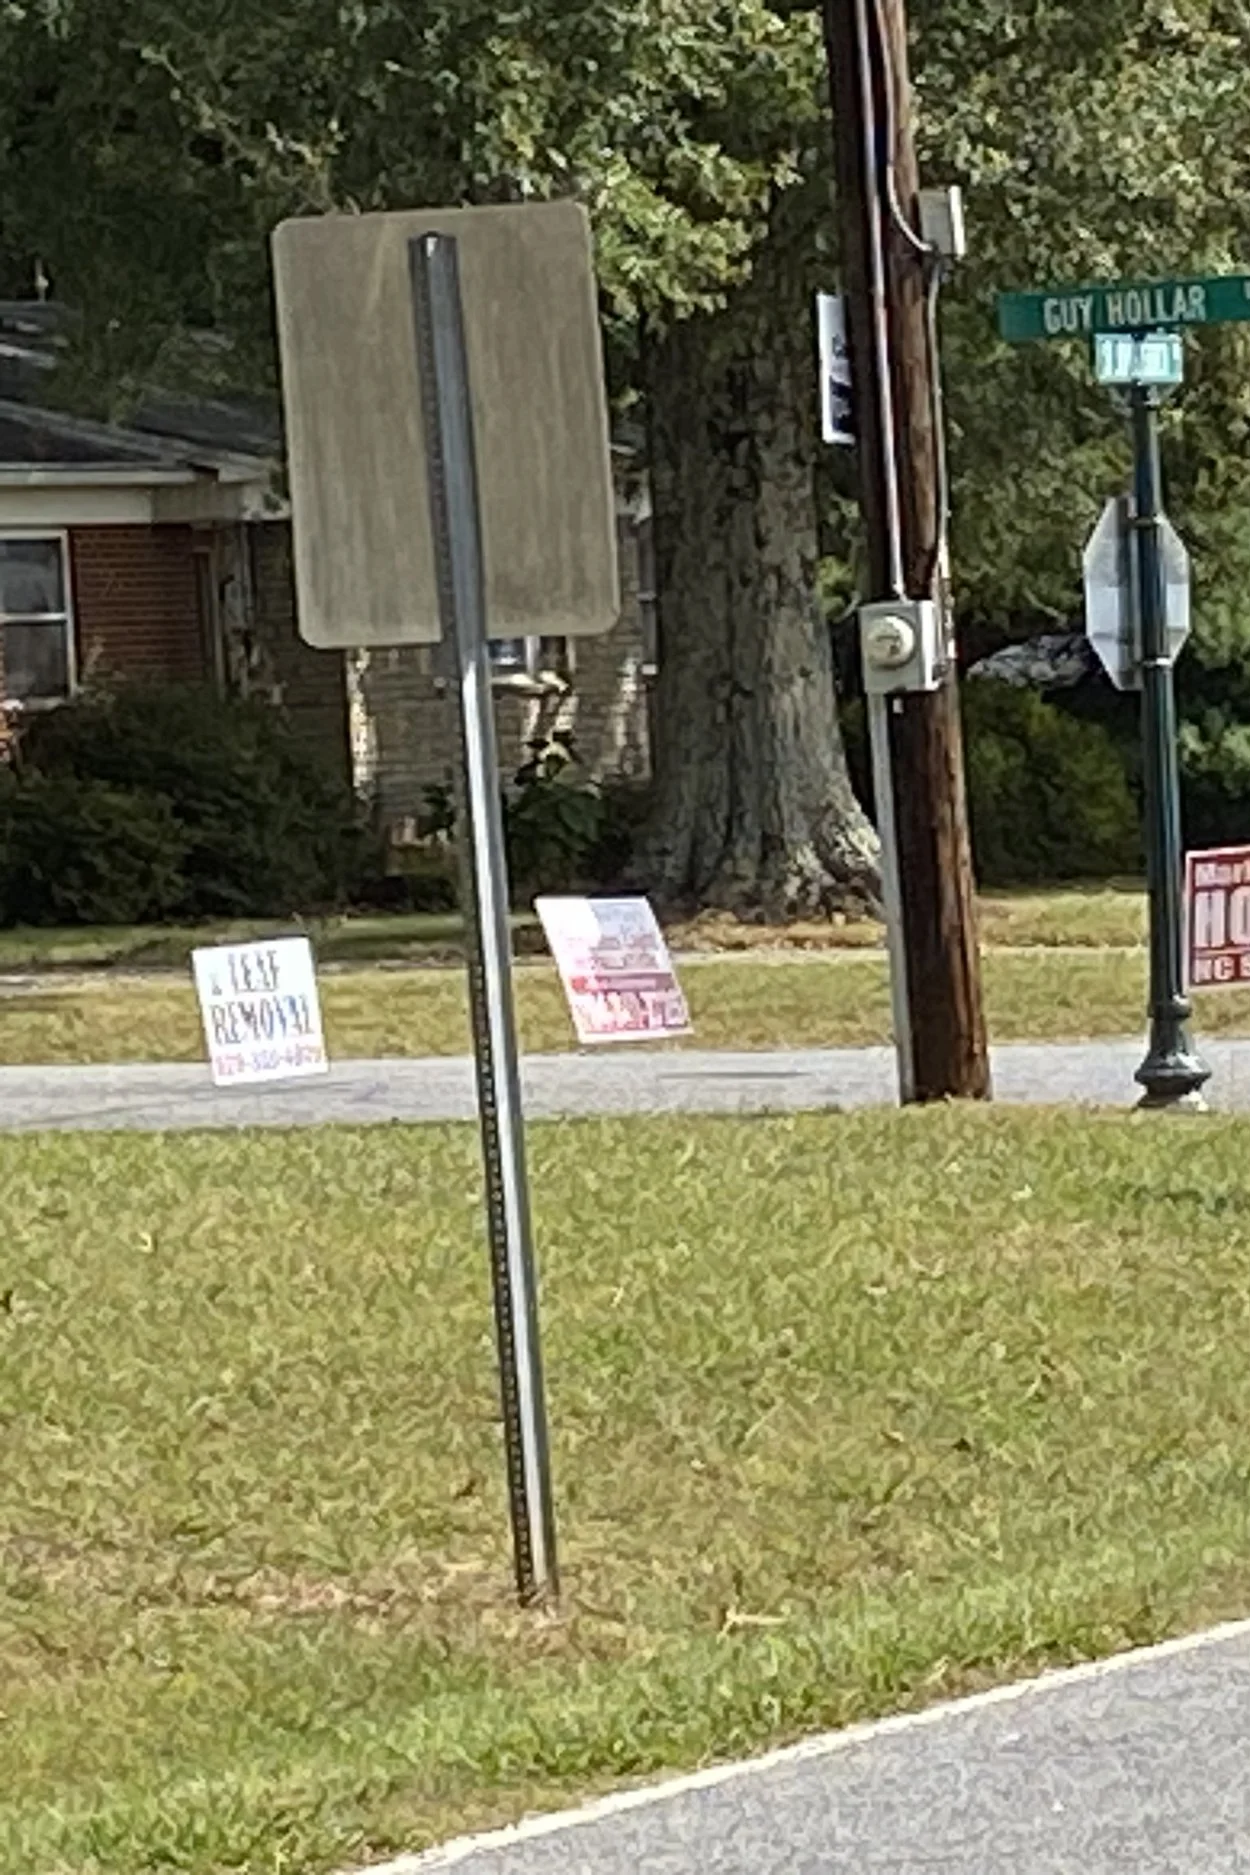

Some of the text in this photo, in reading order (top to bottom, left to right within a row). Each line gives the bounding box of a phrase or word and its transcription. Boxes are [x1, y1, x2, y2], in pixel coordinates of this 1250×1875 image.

[1043, 297, 1093, 334] GUY
[1106, 285, 1206, 326] HOLLAR
[228, 950, 280, 993] LEAF
[210, 994, 314, 1046] REMOVAL
